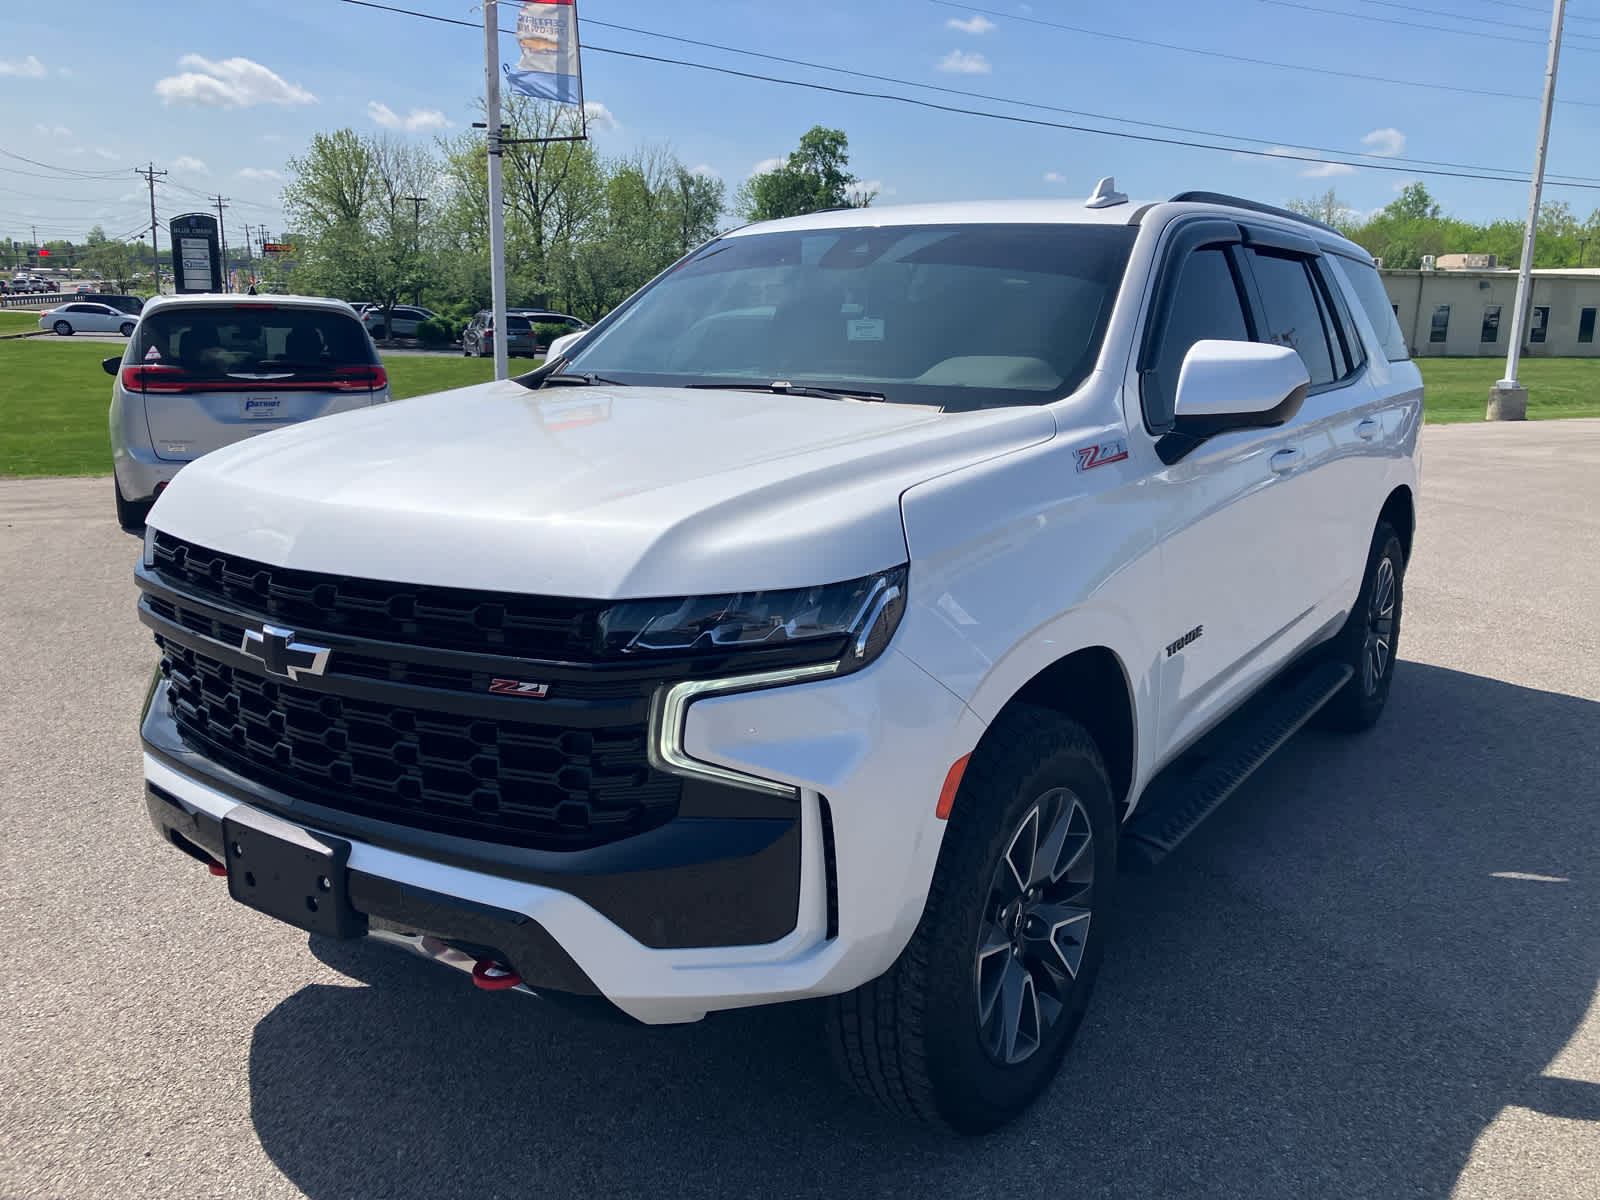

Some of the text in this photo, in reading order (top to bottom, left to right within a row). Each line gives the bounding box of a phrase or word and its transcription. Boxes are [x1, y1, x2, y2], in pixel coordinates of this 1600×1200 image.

[1075, 441, 1129, 471] Z71
[1165, 624, 1204, 658] TAHOE
[488, 678, 549, 698] Z71
